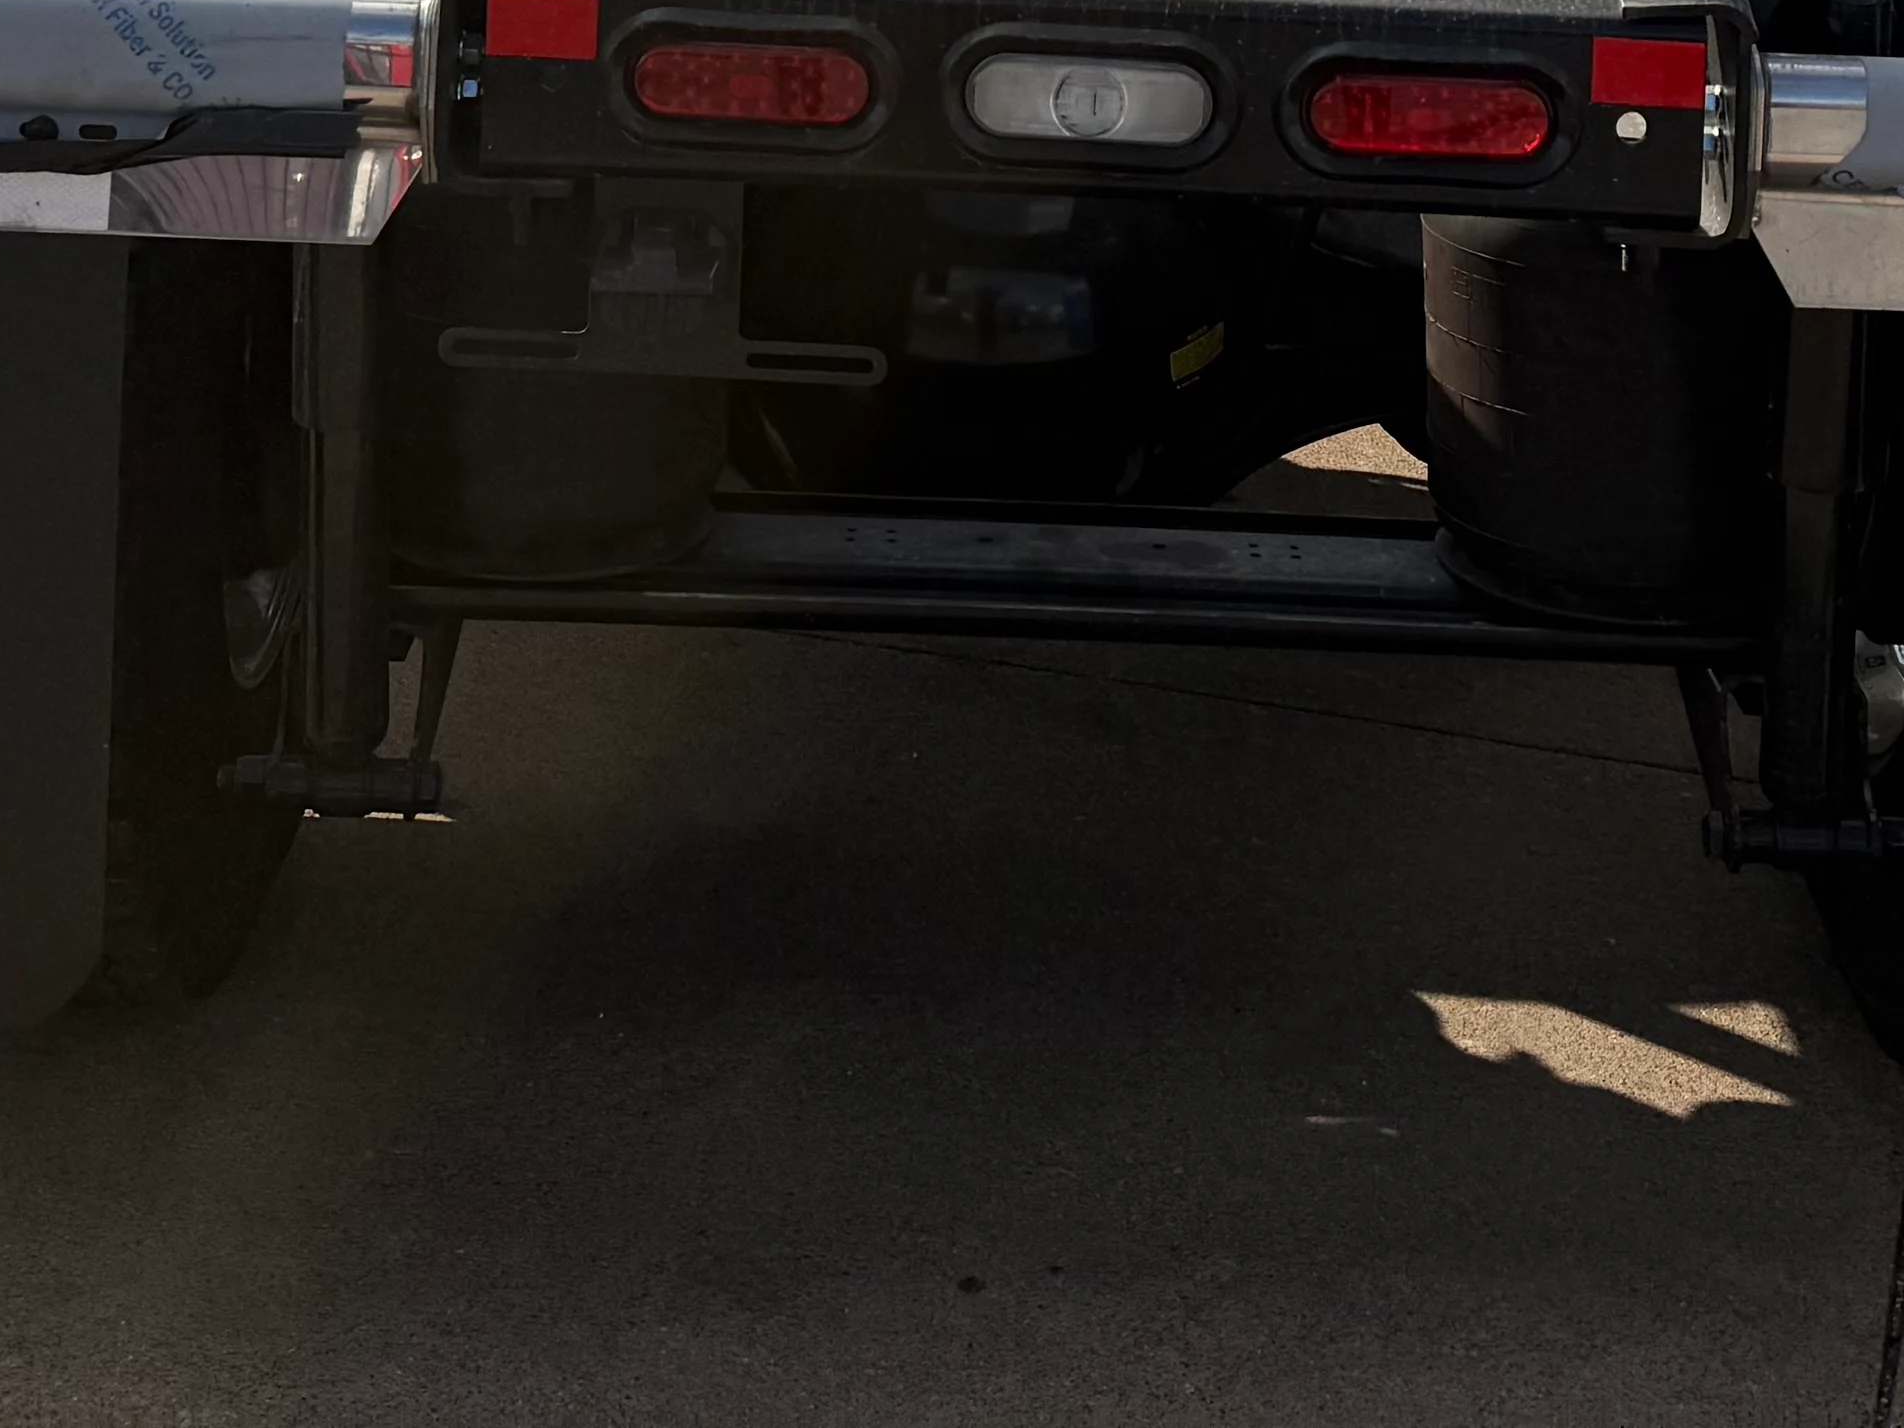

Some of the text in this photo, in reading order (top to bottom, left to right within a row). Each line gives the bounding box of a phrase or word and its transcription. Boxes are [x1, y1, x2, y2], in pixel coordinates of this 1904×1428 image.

[105, 6, 152, 57] Fiber
[147, 54, 167, 75] &
[148, 0, 217, 82] Solution
